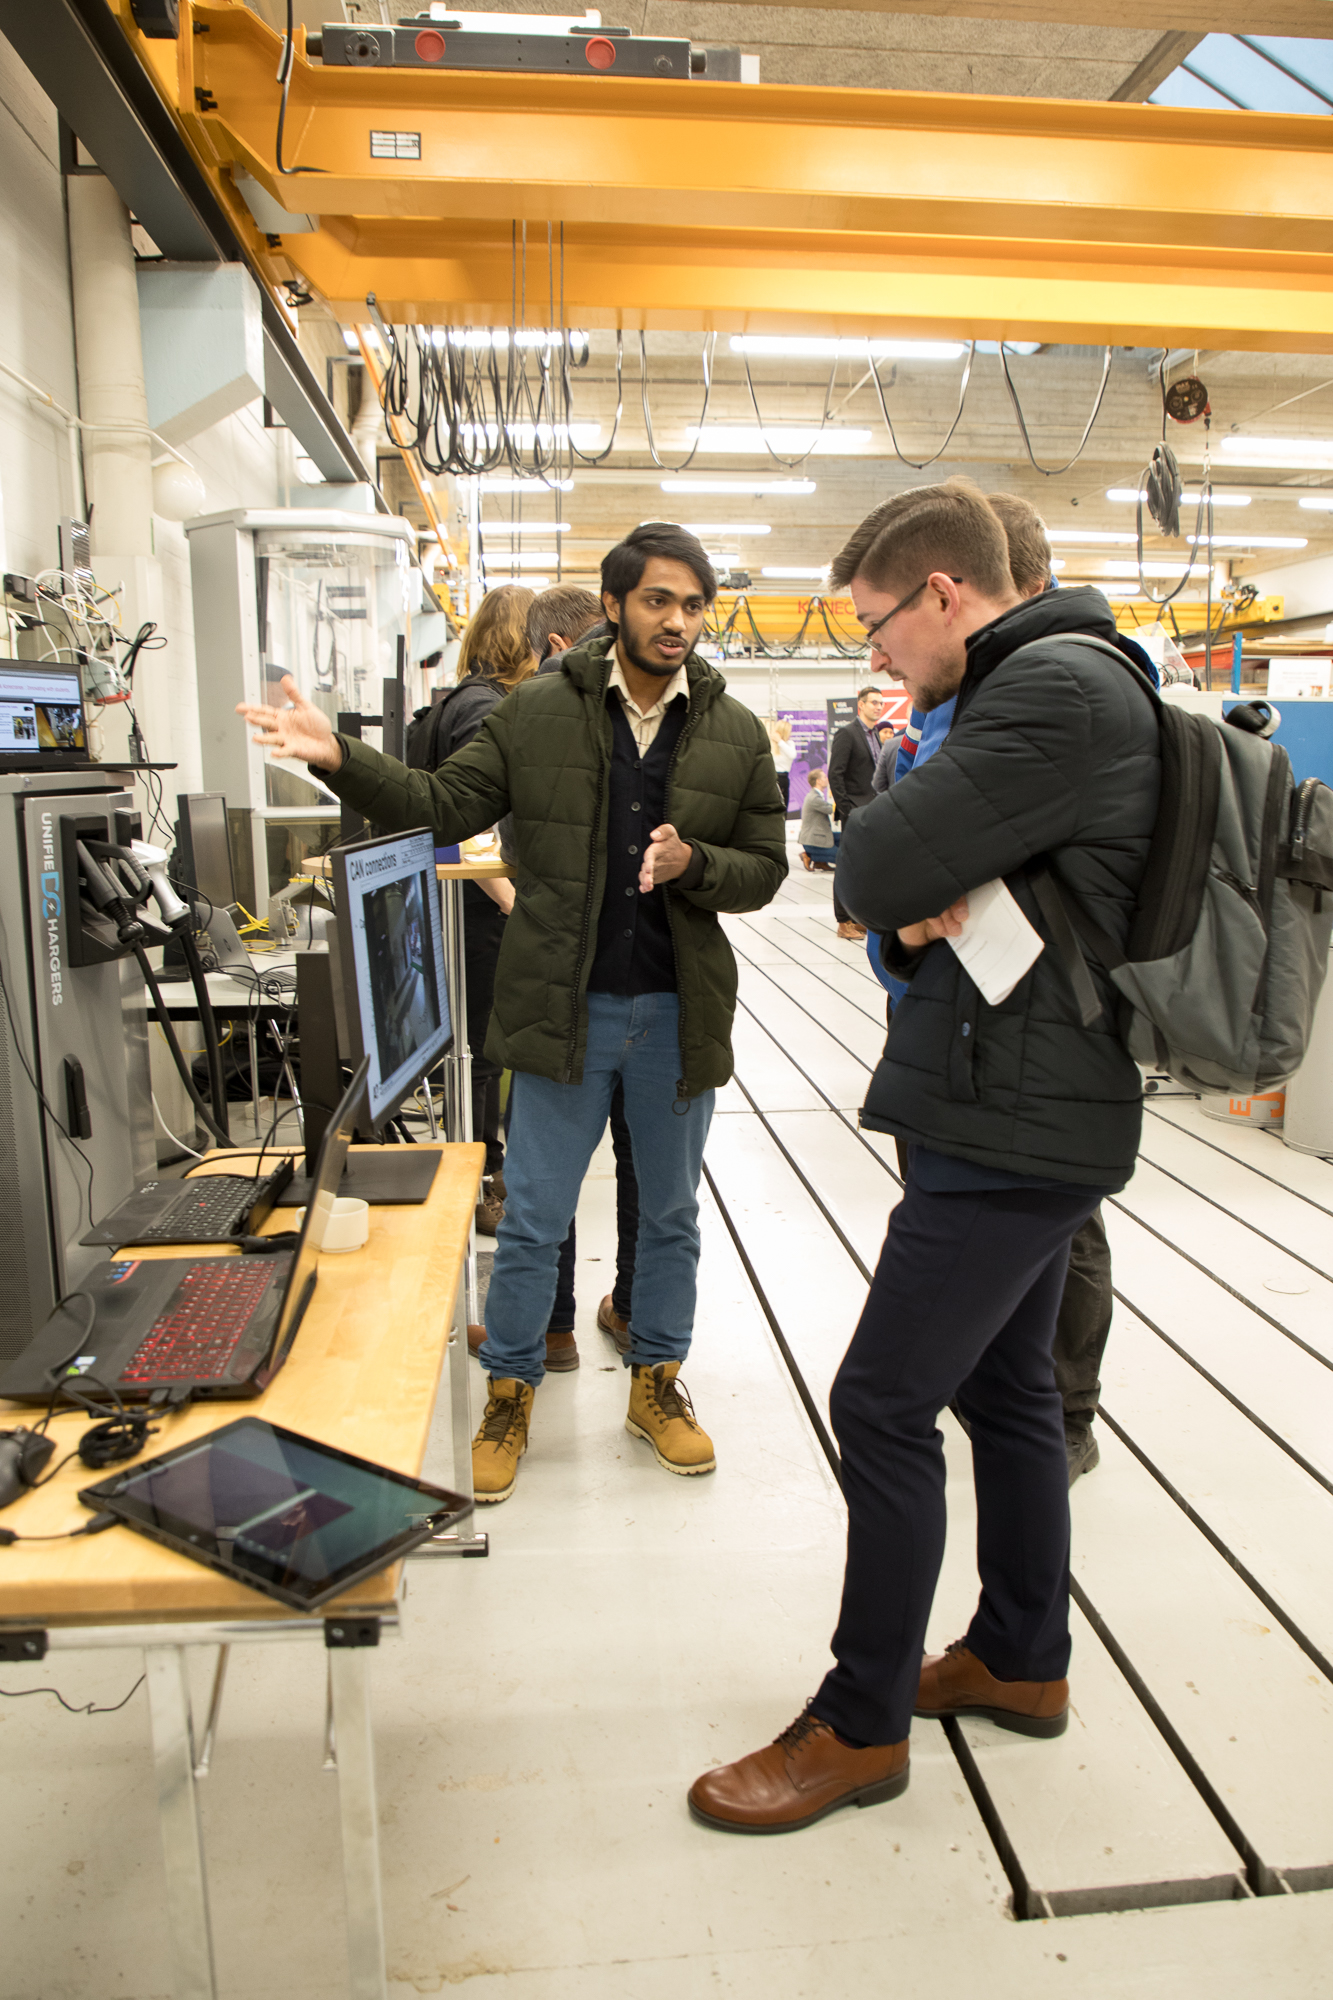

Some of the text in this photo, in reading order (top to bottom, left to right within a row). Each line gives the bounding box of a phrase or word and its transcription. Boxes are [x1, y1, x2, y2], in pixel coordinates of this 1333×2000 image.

[798, 600, 856, 615] KNEC
[350, 853, 397, 881] CAN connections
